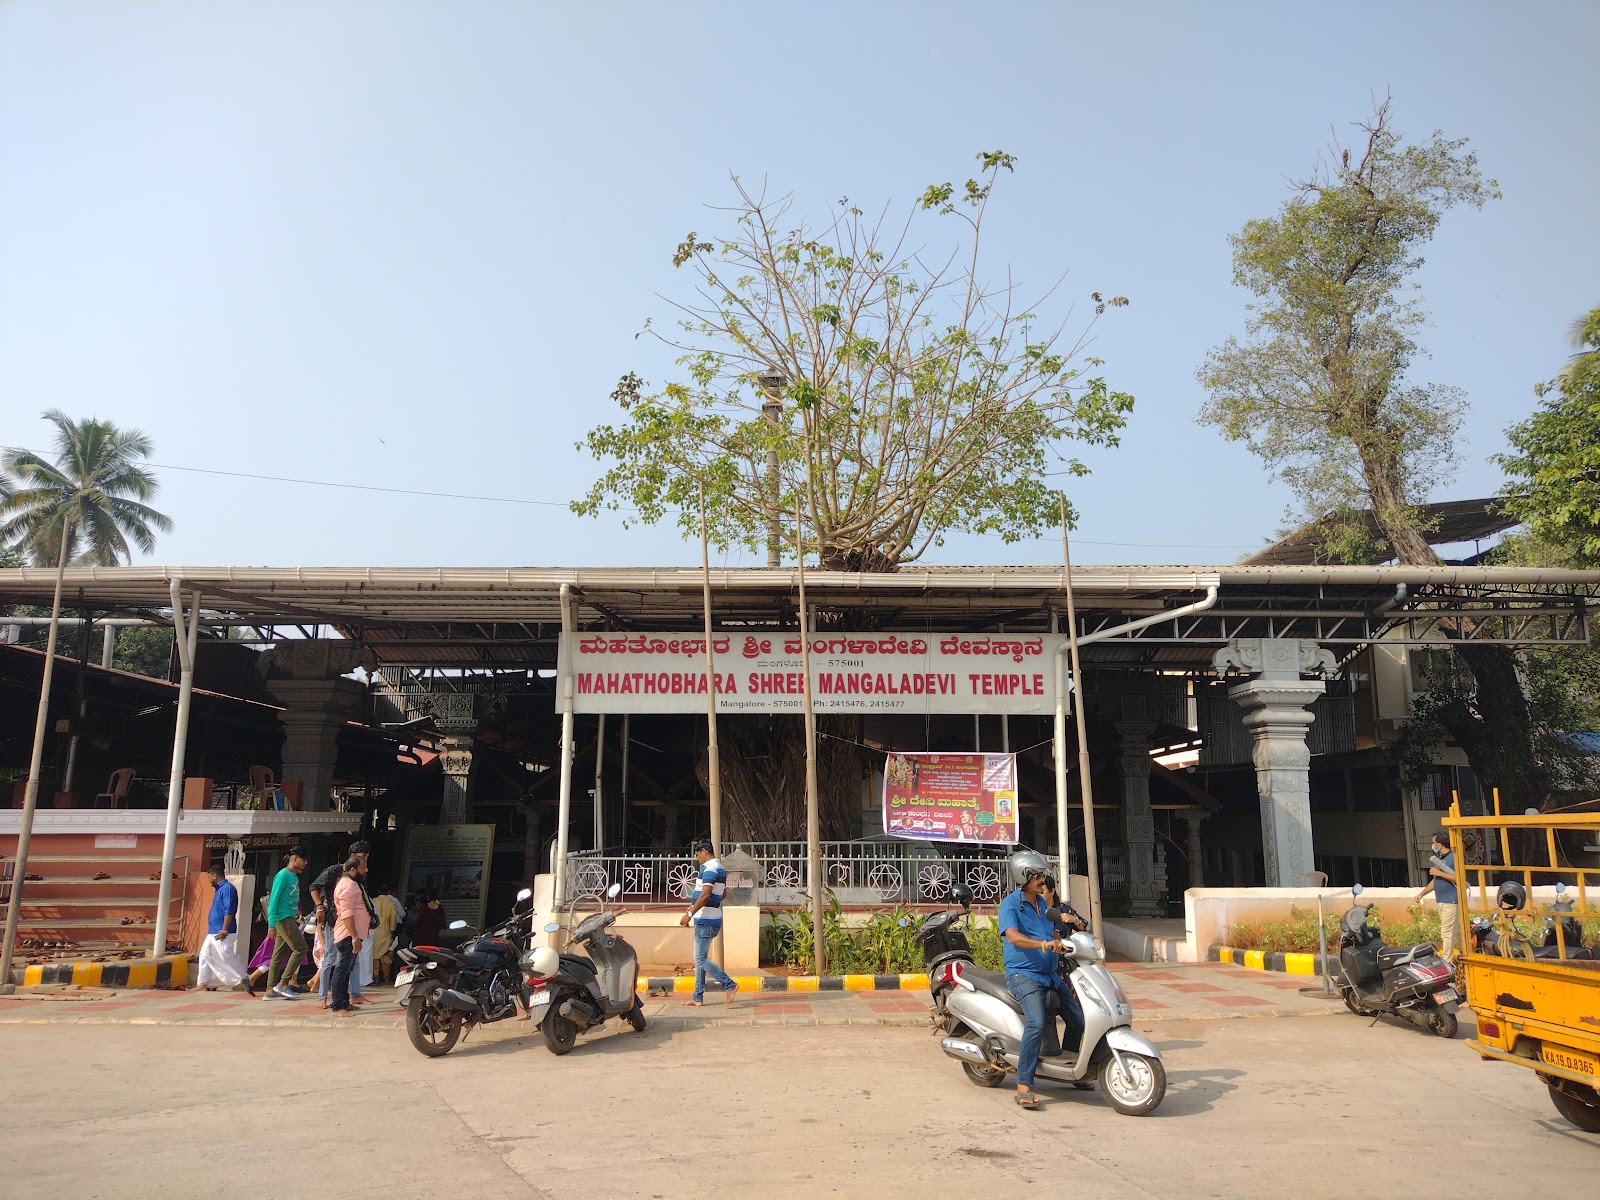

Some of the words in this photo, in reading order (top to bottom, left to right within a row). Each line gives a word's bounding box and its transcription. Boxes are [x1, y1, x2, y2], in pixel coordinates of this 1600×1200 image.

[742, 636, 772, 659] ಶ್ರೀ
[784, 635, 928, 655] ಮಂಗಳಾದೇವಿ
[940, 636, 1044, 663] ದೇವಸ್ಥಾನ
[577, 672, 738, 694] MAHATHOBHARA
[748, 672, 806, 694] SHREE
[818, 673, 956, 695] MANGALADEVI
[968, 673, 1045, 695] TEMPLE
[720, 700, 766, 709] Mangalore
[1544, 1050, 1595, 1075] KA.19.D.8365
